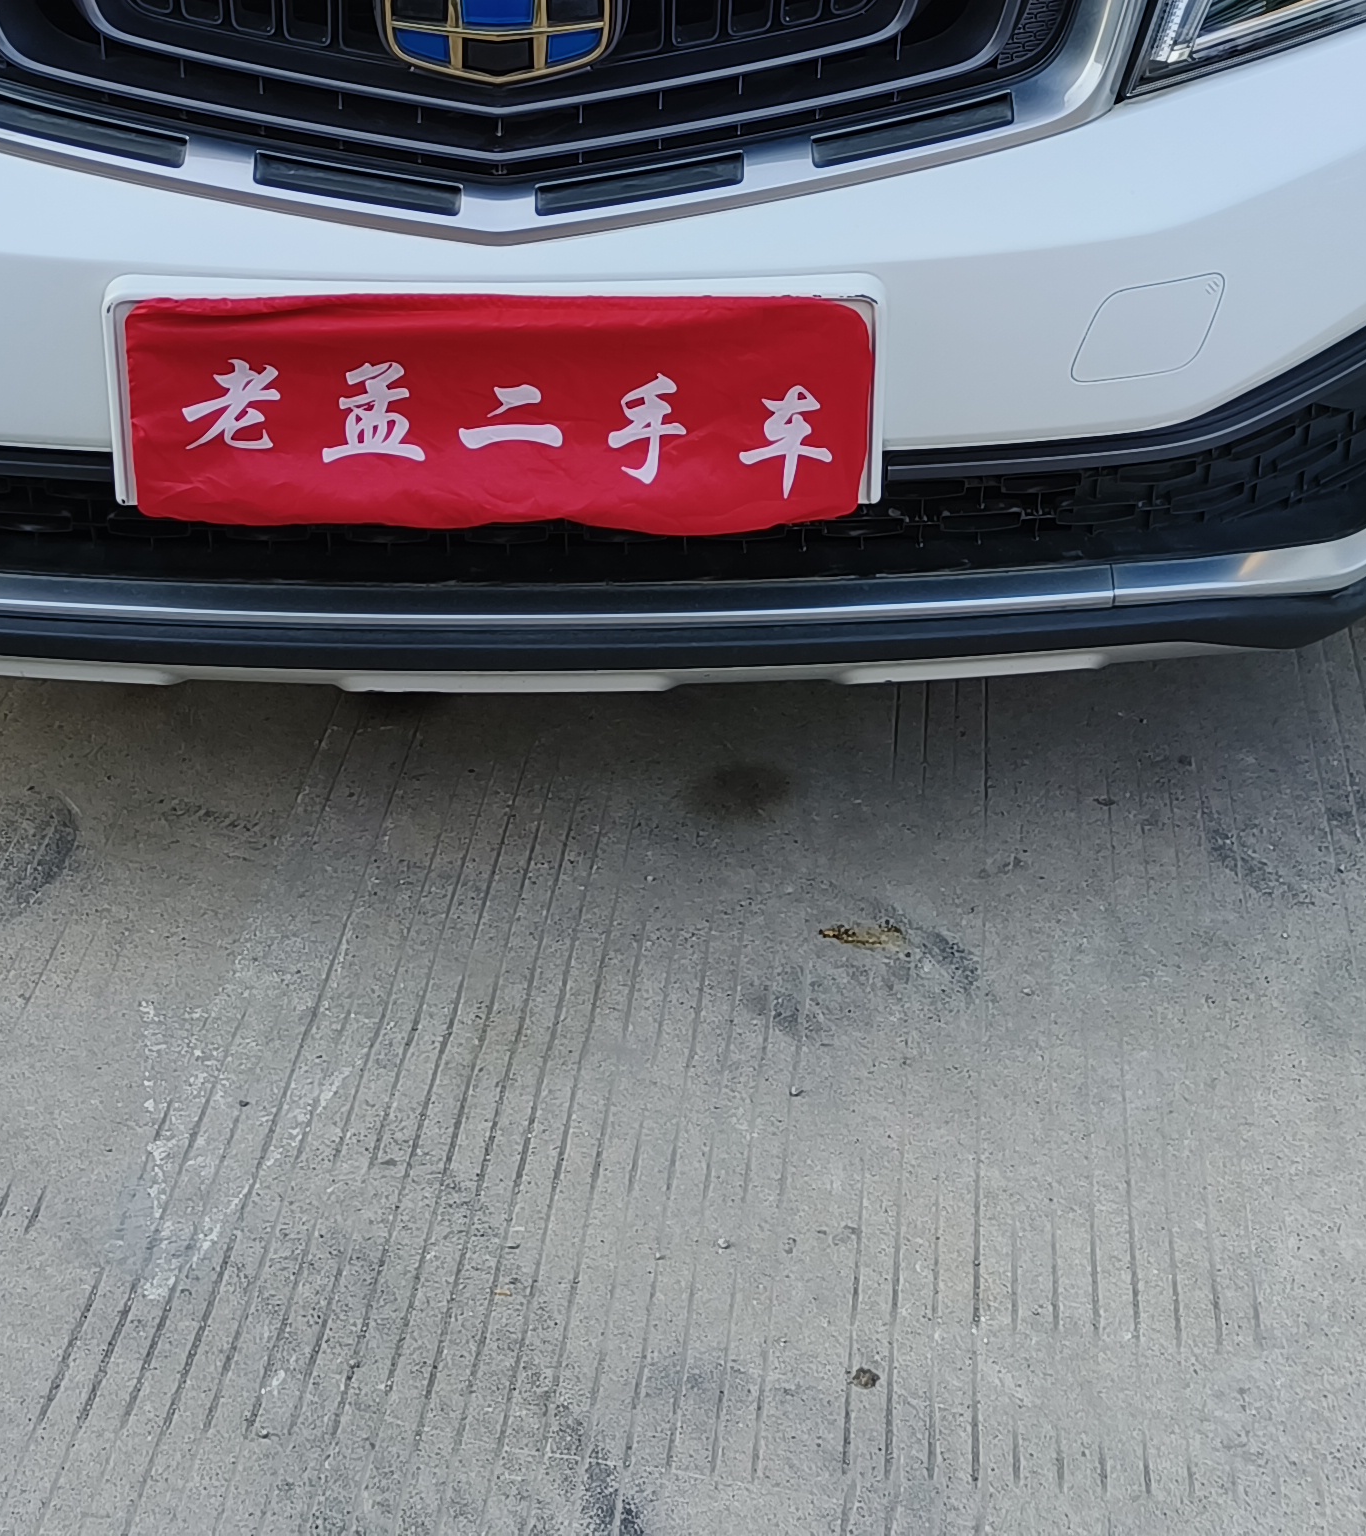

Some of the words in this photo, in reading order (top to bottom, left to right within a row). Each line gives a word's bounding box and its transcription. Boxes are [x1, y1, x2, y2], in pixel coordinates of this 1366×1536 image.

[180, 357, 834, 500] 老孟二手车
